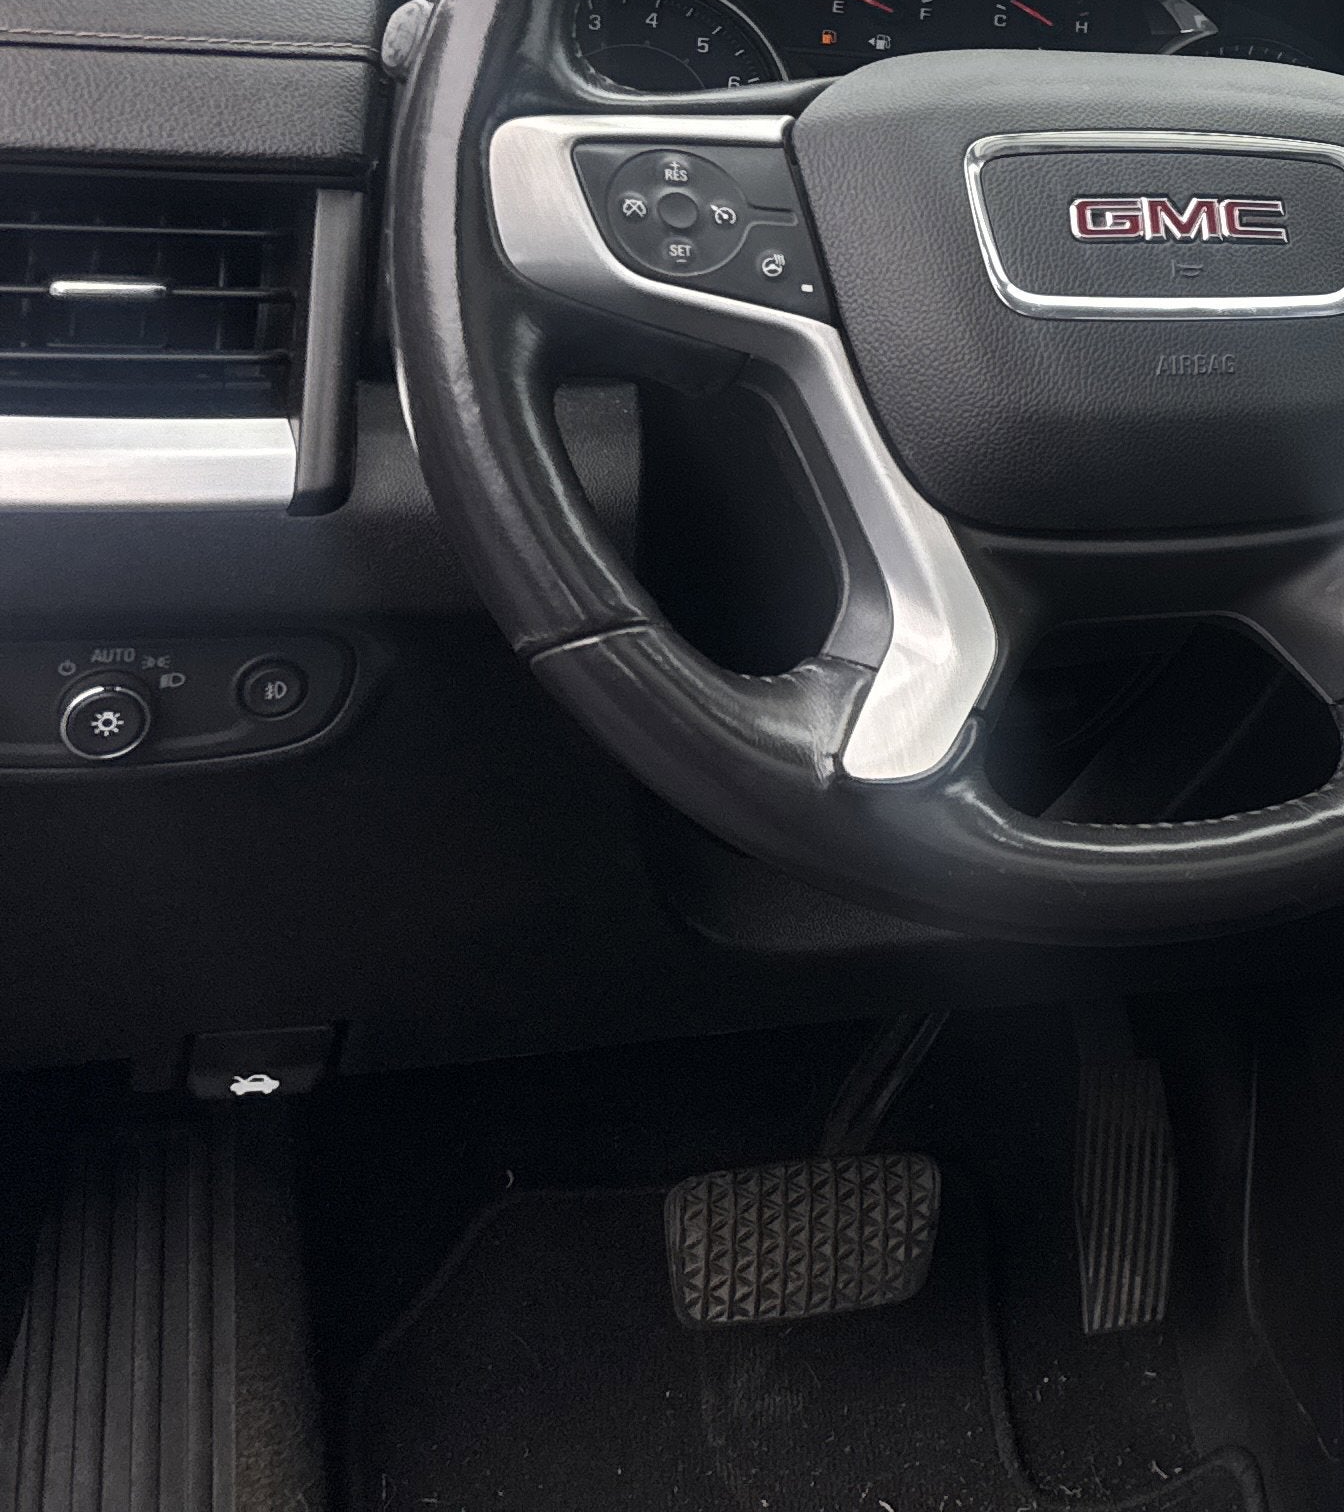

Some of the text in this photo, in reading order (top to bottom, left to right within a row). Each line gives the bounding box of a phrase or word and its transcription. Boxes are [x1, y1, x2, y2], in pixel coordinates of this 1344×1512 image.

[832, 0, 845, 14] E
[918, 6, 932, 22] F
[588, 13, 603, 31] 3
[644, 11, 660, 29] 4
[993, 12, 1007, 28] C
[1075, 20, 1089, 34] H
[696, 36, 710, 54] 5
[664, 169, 688, 182] RES
[1069, 197, 1289, 244] GMC
[669, 244, 692, 257] SET
[1156, 354, 1236, 376] AIRBAG
[90, 648, 136, 664] AUTO
